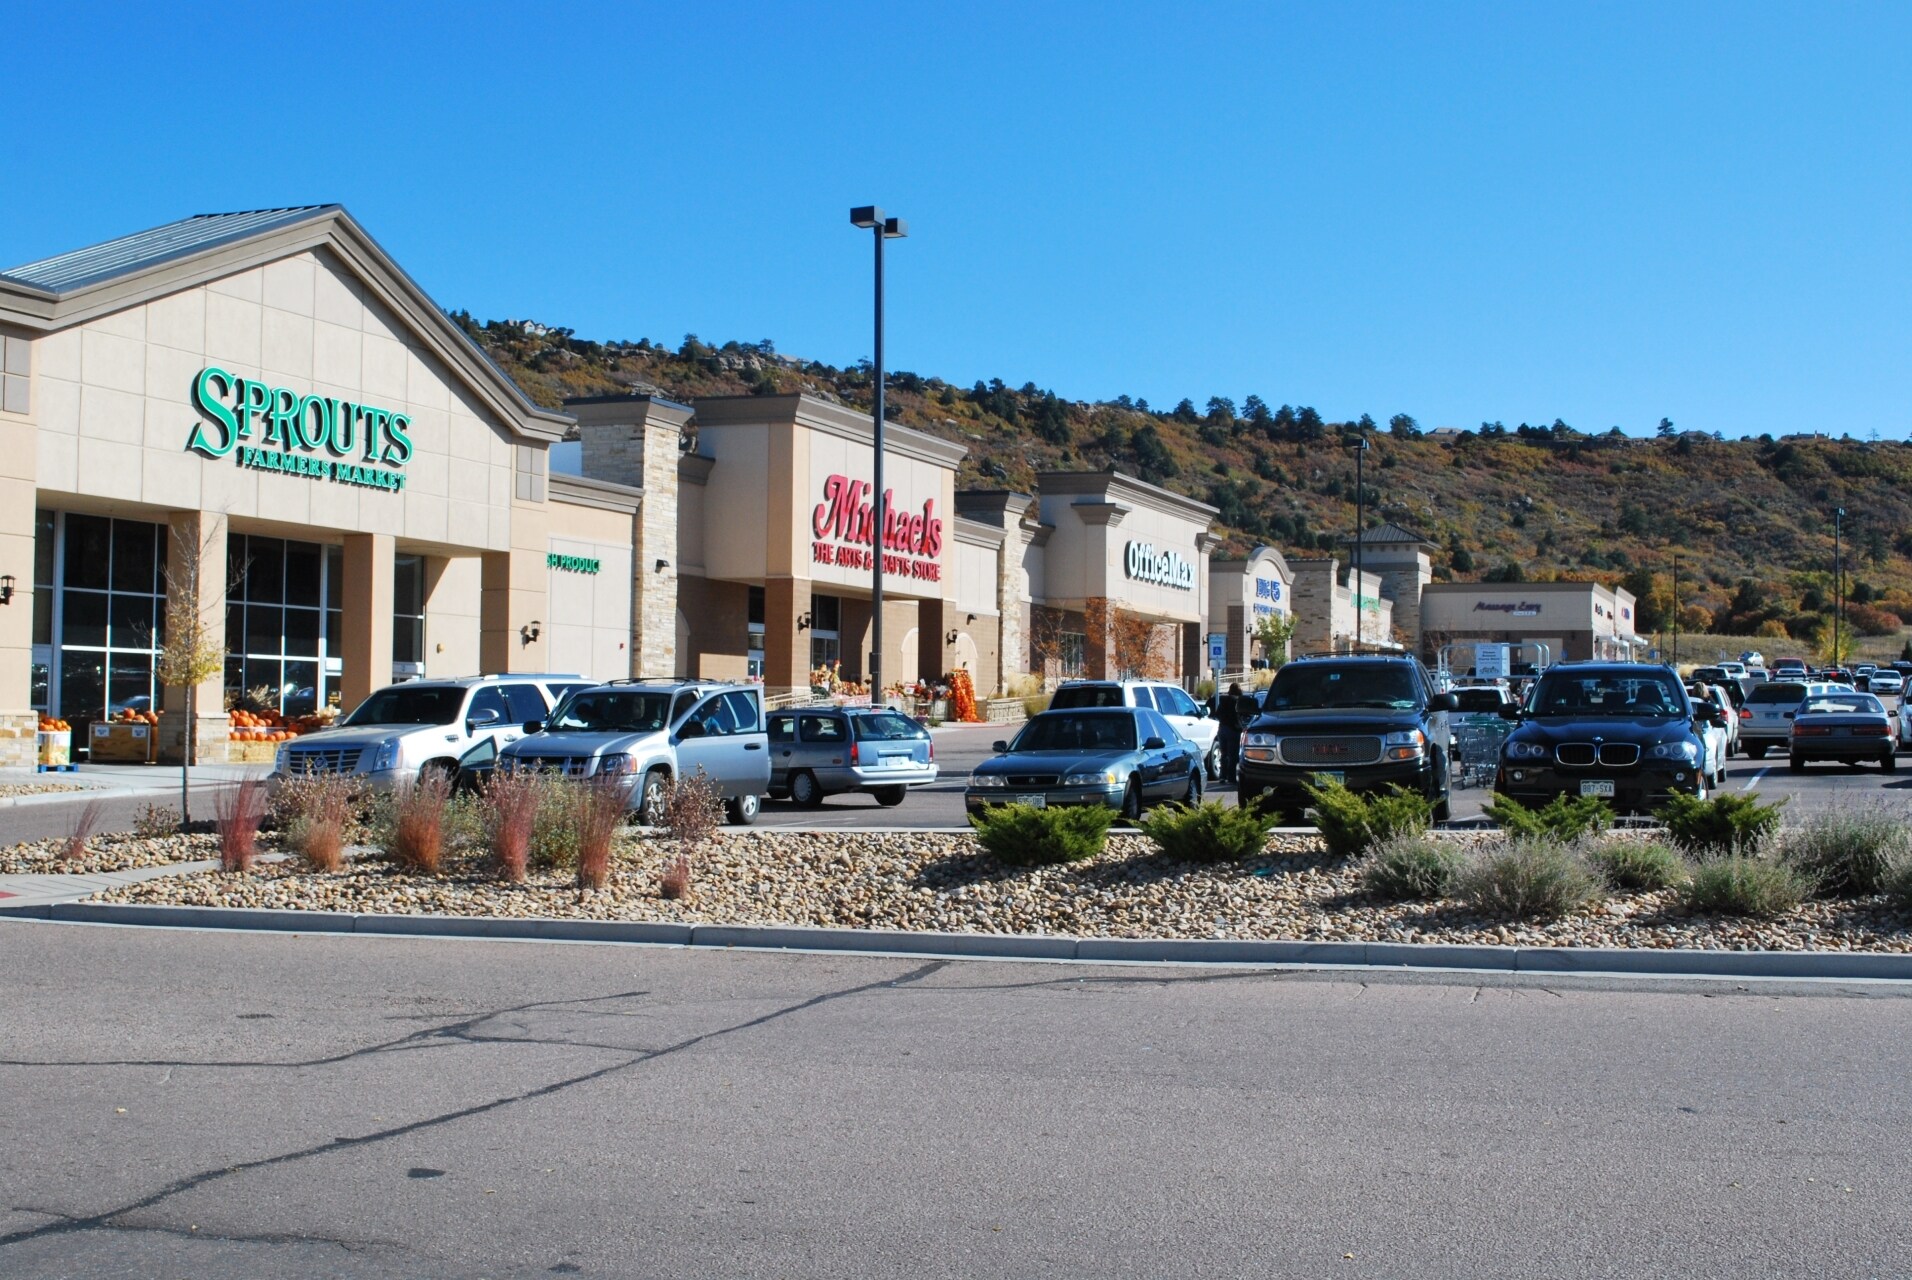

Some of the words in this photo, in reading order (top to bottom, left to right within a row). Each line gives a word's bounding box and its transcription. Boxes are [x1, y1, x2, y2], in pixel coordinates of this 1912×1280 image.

[186, 366, 414, 466] SPROUTS
[239, 446, 331, 478] FARMERS
[332, 463, 407, 492] MARKET
[812, 542, 834, 565] THE
[836, 546, 863, 570] ARTS
[864, 551, 873, 571] &
[882, 553, 911, 577] RAFTS
[912, 560, 941, 582] STORE
[1125, 540, 1195, 591] OfficeMax
[1271, 580, 1281, 603] 5
